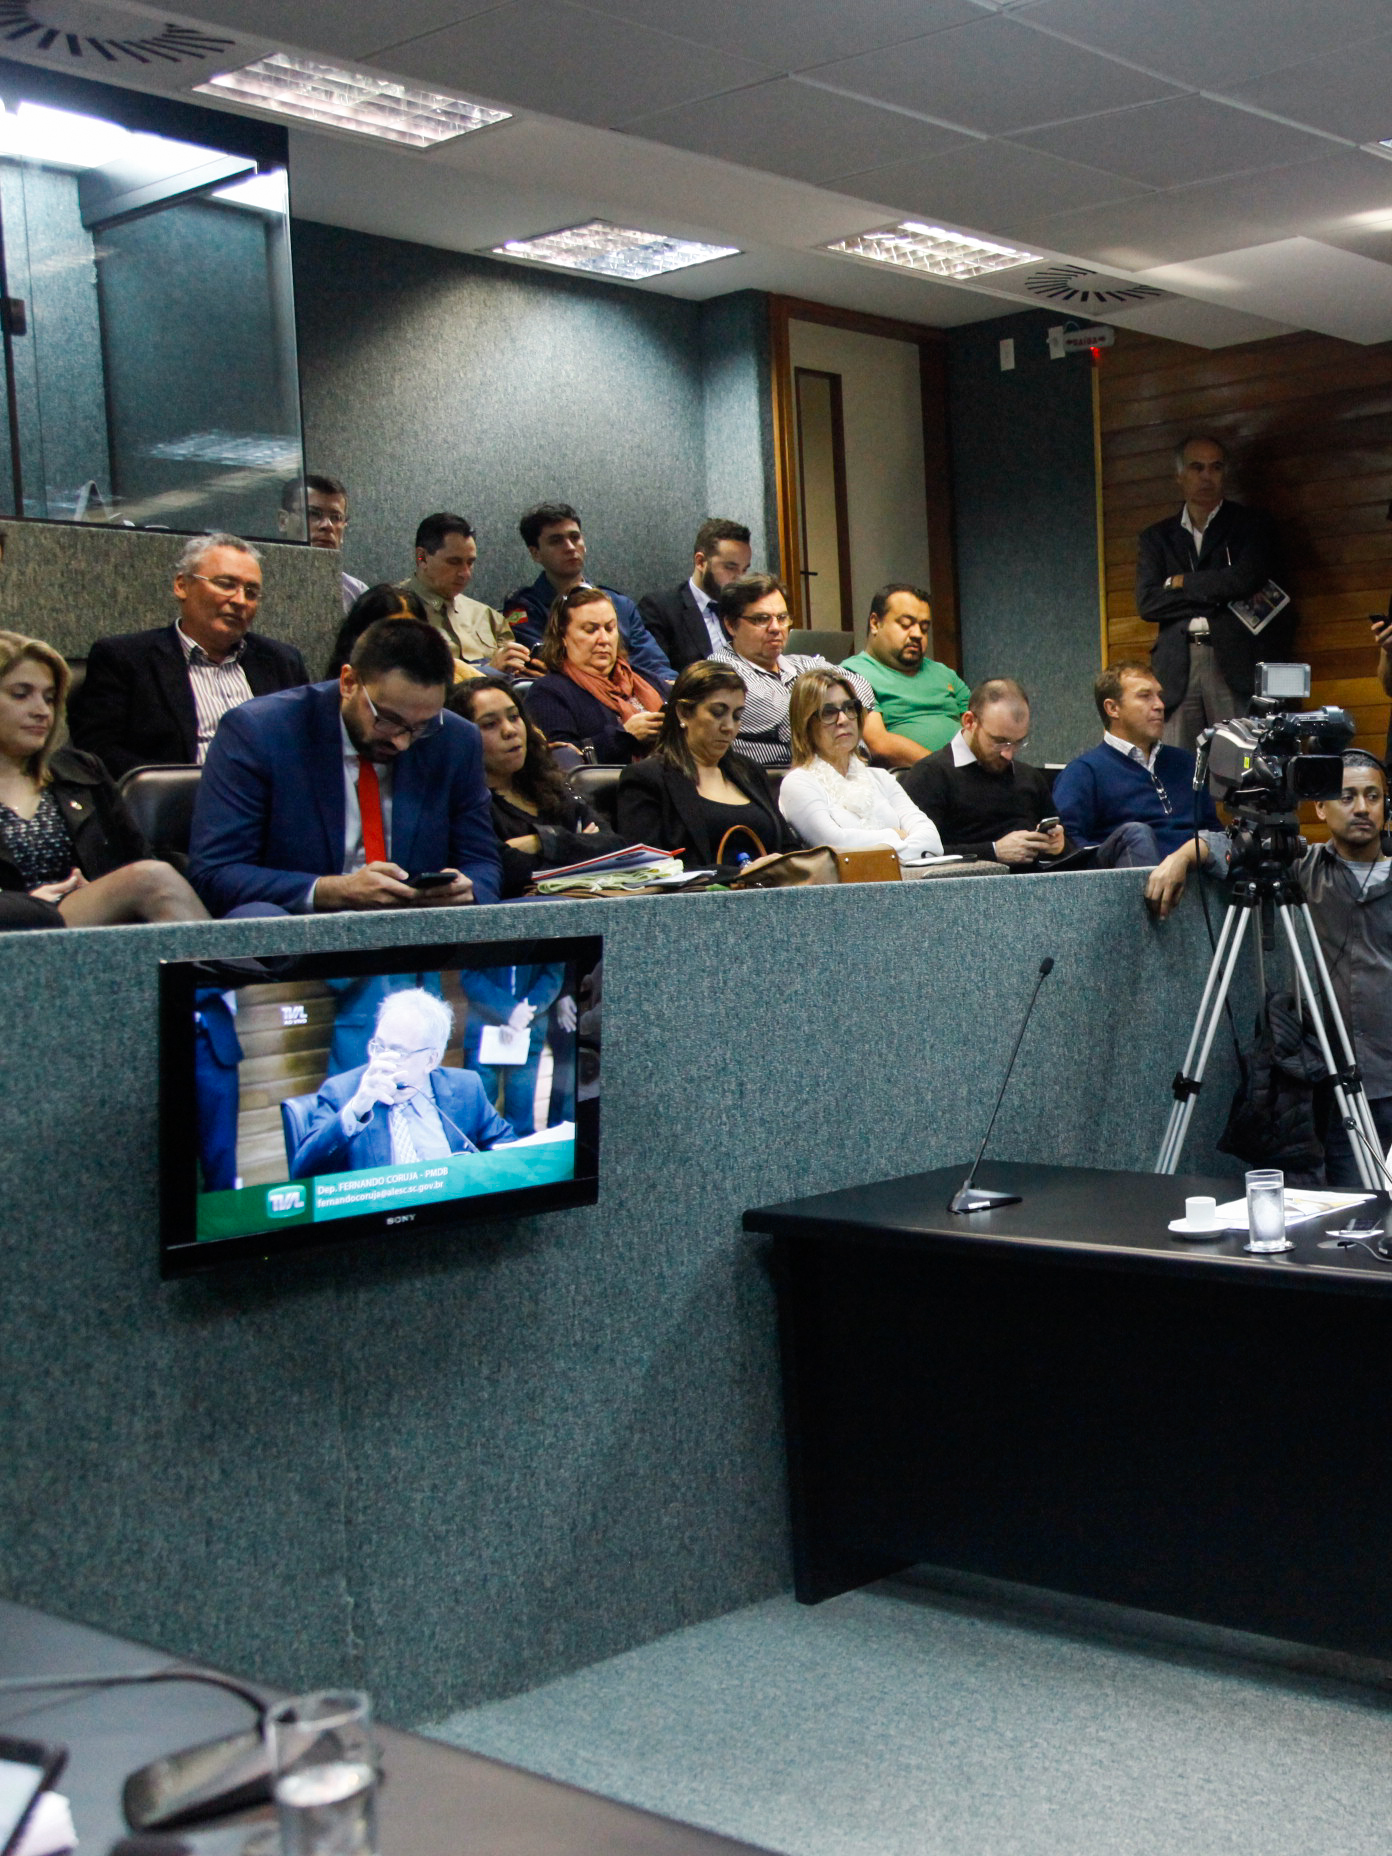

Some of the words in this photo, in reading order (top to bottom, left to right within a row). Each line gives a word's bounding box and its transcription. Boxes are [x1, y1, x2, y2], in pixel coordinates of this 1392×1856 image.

[317, 1185, 338, 1196] Dep.
[338, 1176, 385, 1192] FERNANDO
[386, 1171, 418, 1184] CORUJA
[425, 1166, 449, 1178] PMDB
[317, 1181, 444, 1208] fernandocoruja@alesc.sc.gov.br
[386, 1213, 417, 1225] SONY
